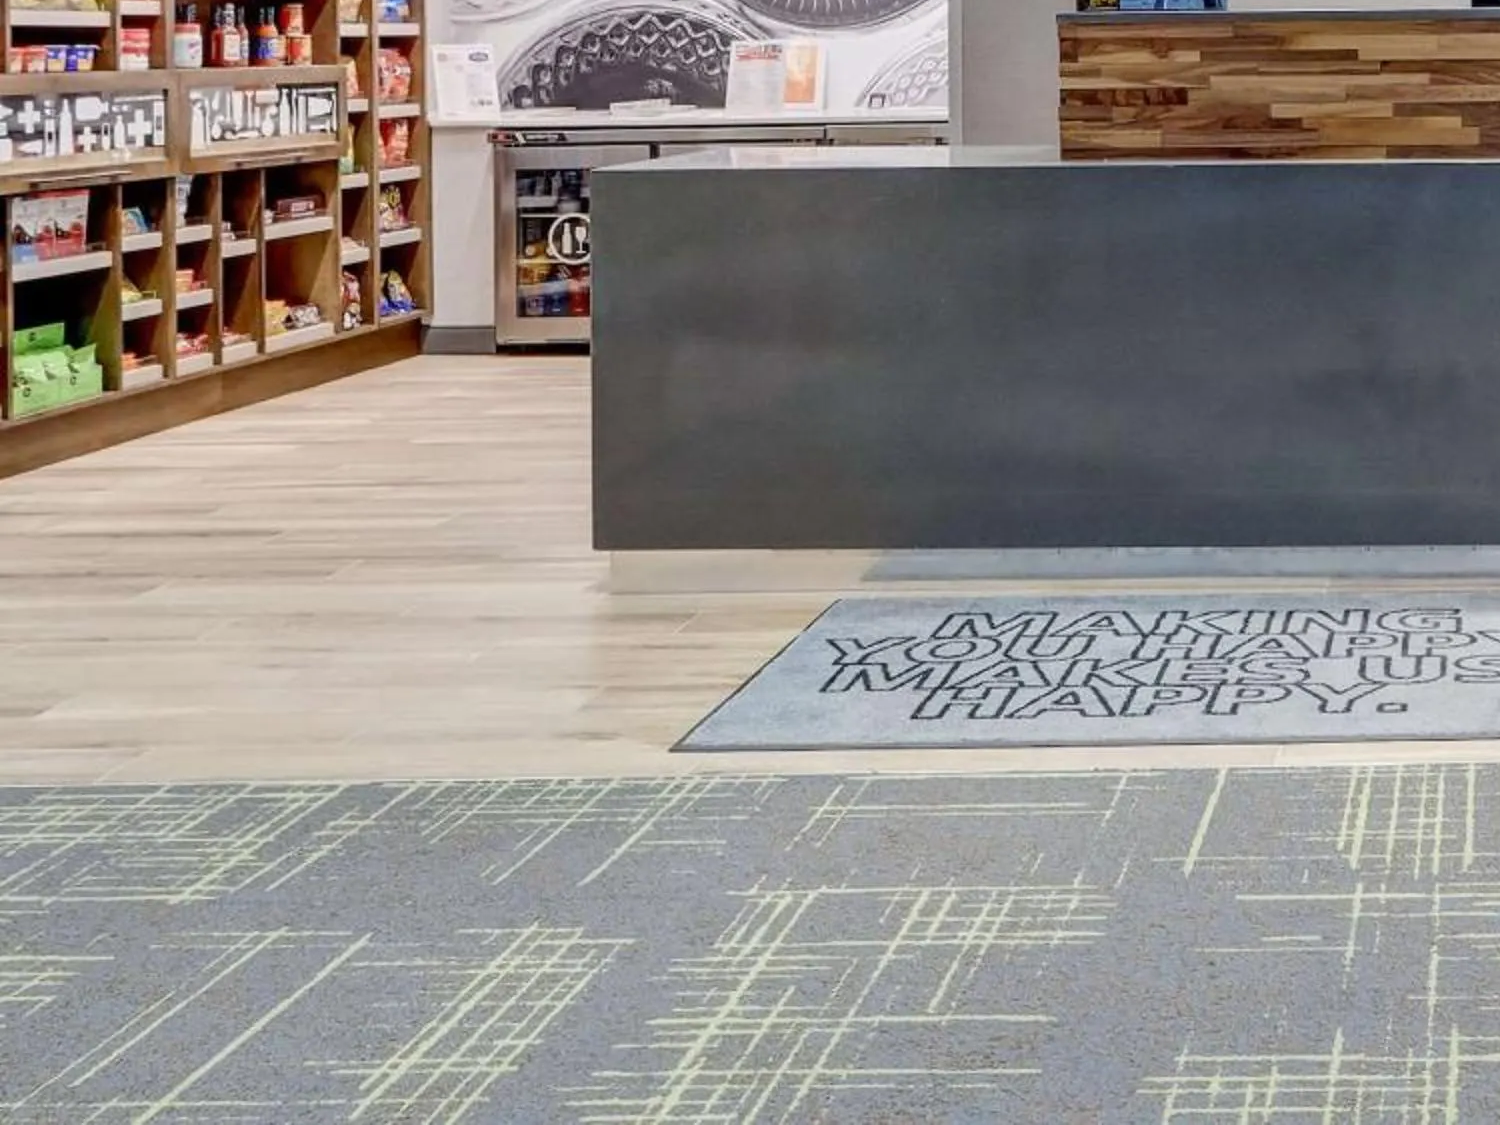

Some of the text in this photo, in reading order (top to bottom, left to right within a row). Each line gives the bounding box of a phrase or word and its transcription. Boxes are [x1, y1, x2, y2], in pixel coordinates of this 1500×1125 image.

[929, 608, 1464, 639] MAKING
[826, 635, 1100, 665] YOU
[818, 656, 1311, 693] MAKES
[910, 681, 1409, 720] HAPPY.
